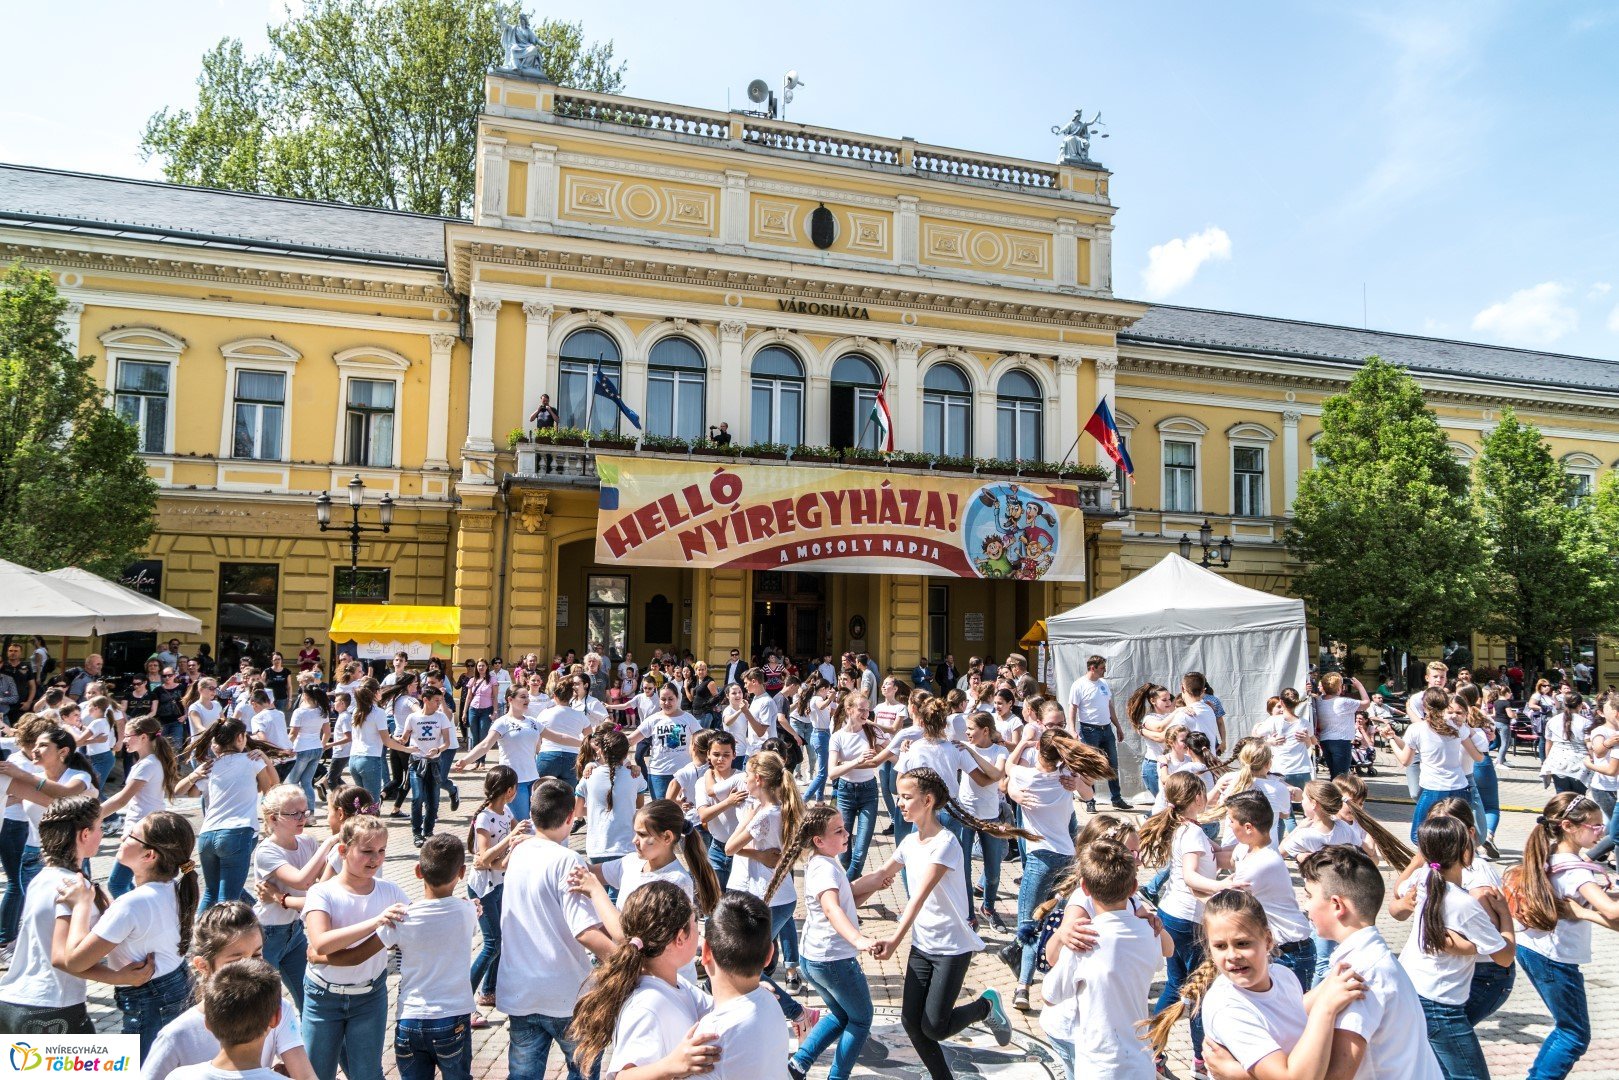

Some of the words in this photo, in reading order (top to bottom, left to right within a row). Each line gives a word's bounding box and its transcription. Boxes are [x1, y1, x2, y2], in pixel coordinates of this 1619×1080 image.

[777, 297, 870, 320] VÁROSHÁZA
[602, 466, 743, 560] HELLÓ
[677, 478, 959, 562] NYÍREGYHÁZA!
[780, 549, 789, 563] A
[796, 539, 873, 559] MOSOLY
[882, 539, 940, 561] NAPJA
[656, 724, 687, 734] HAPY
[657, 734, 687, 748] TE
